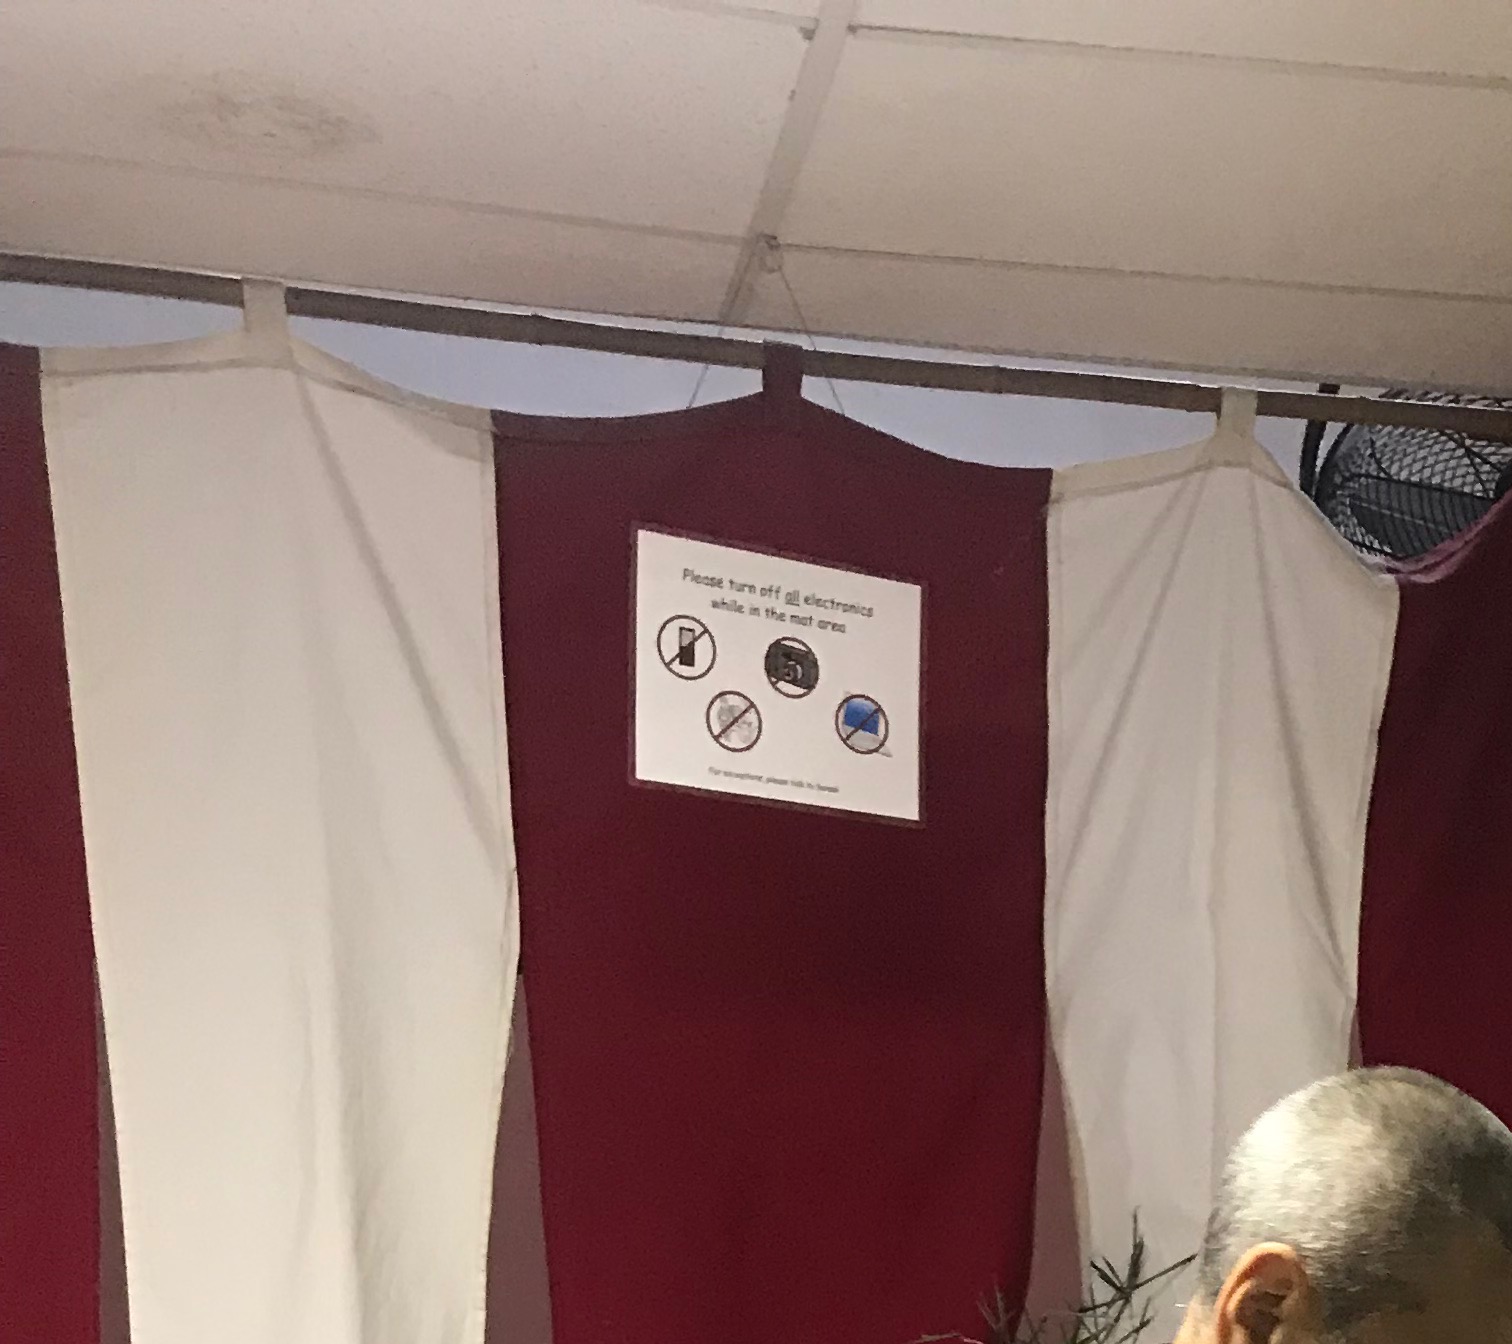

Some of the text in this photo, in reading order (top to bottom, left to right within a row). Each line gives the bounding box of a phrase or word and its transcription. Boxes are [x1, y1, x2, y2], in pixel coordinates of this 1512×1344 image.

[682, 567, 874, 618] Please turn off all electronics
[711, 597, 847, 633] while in the mat area
